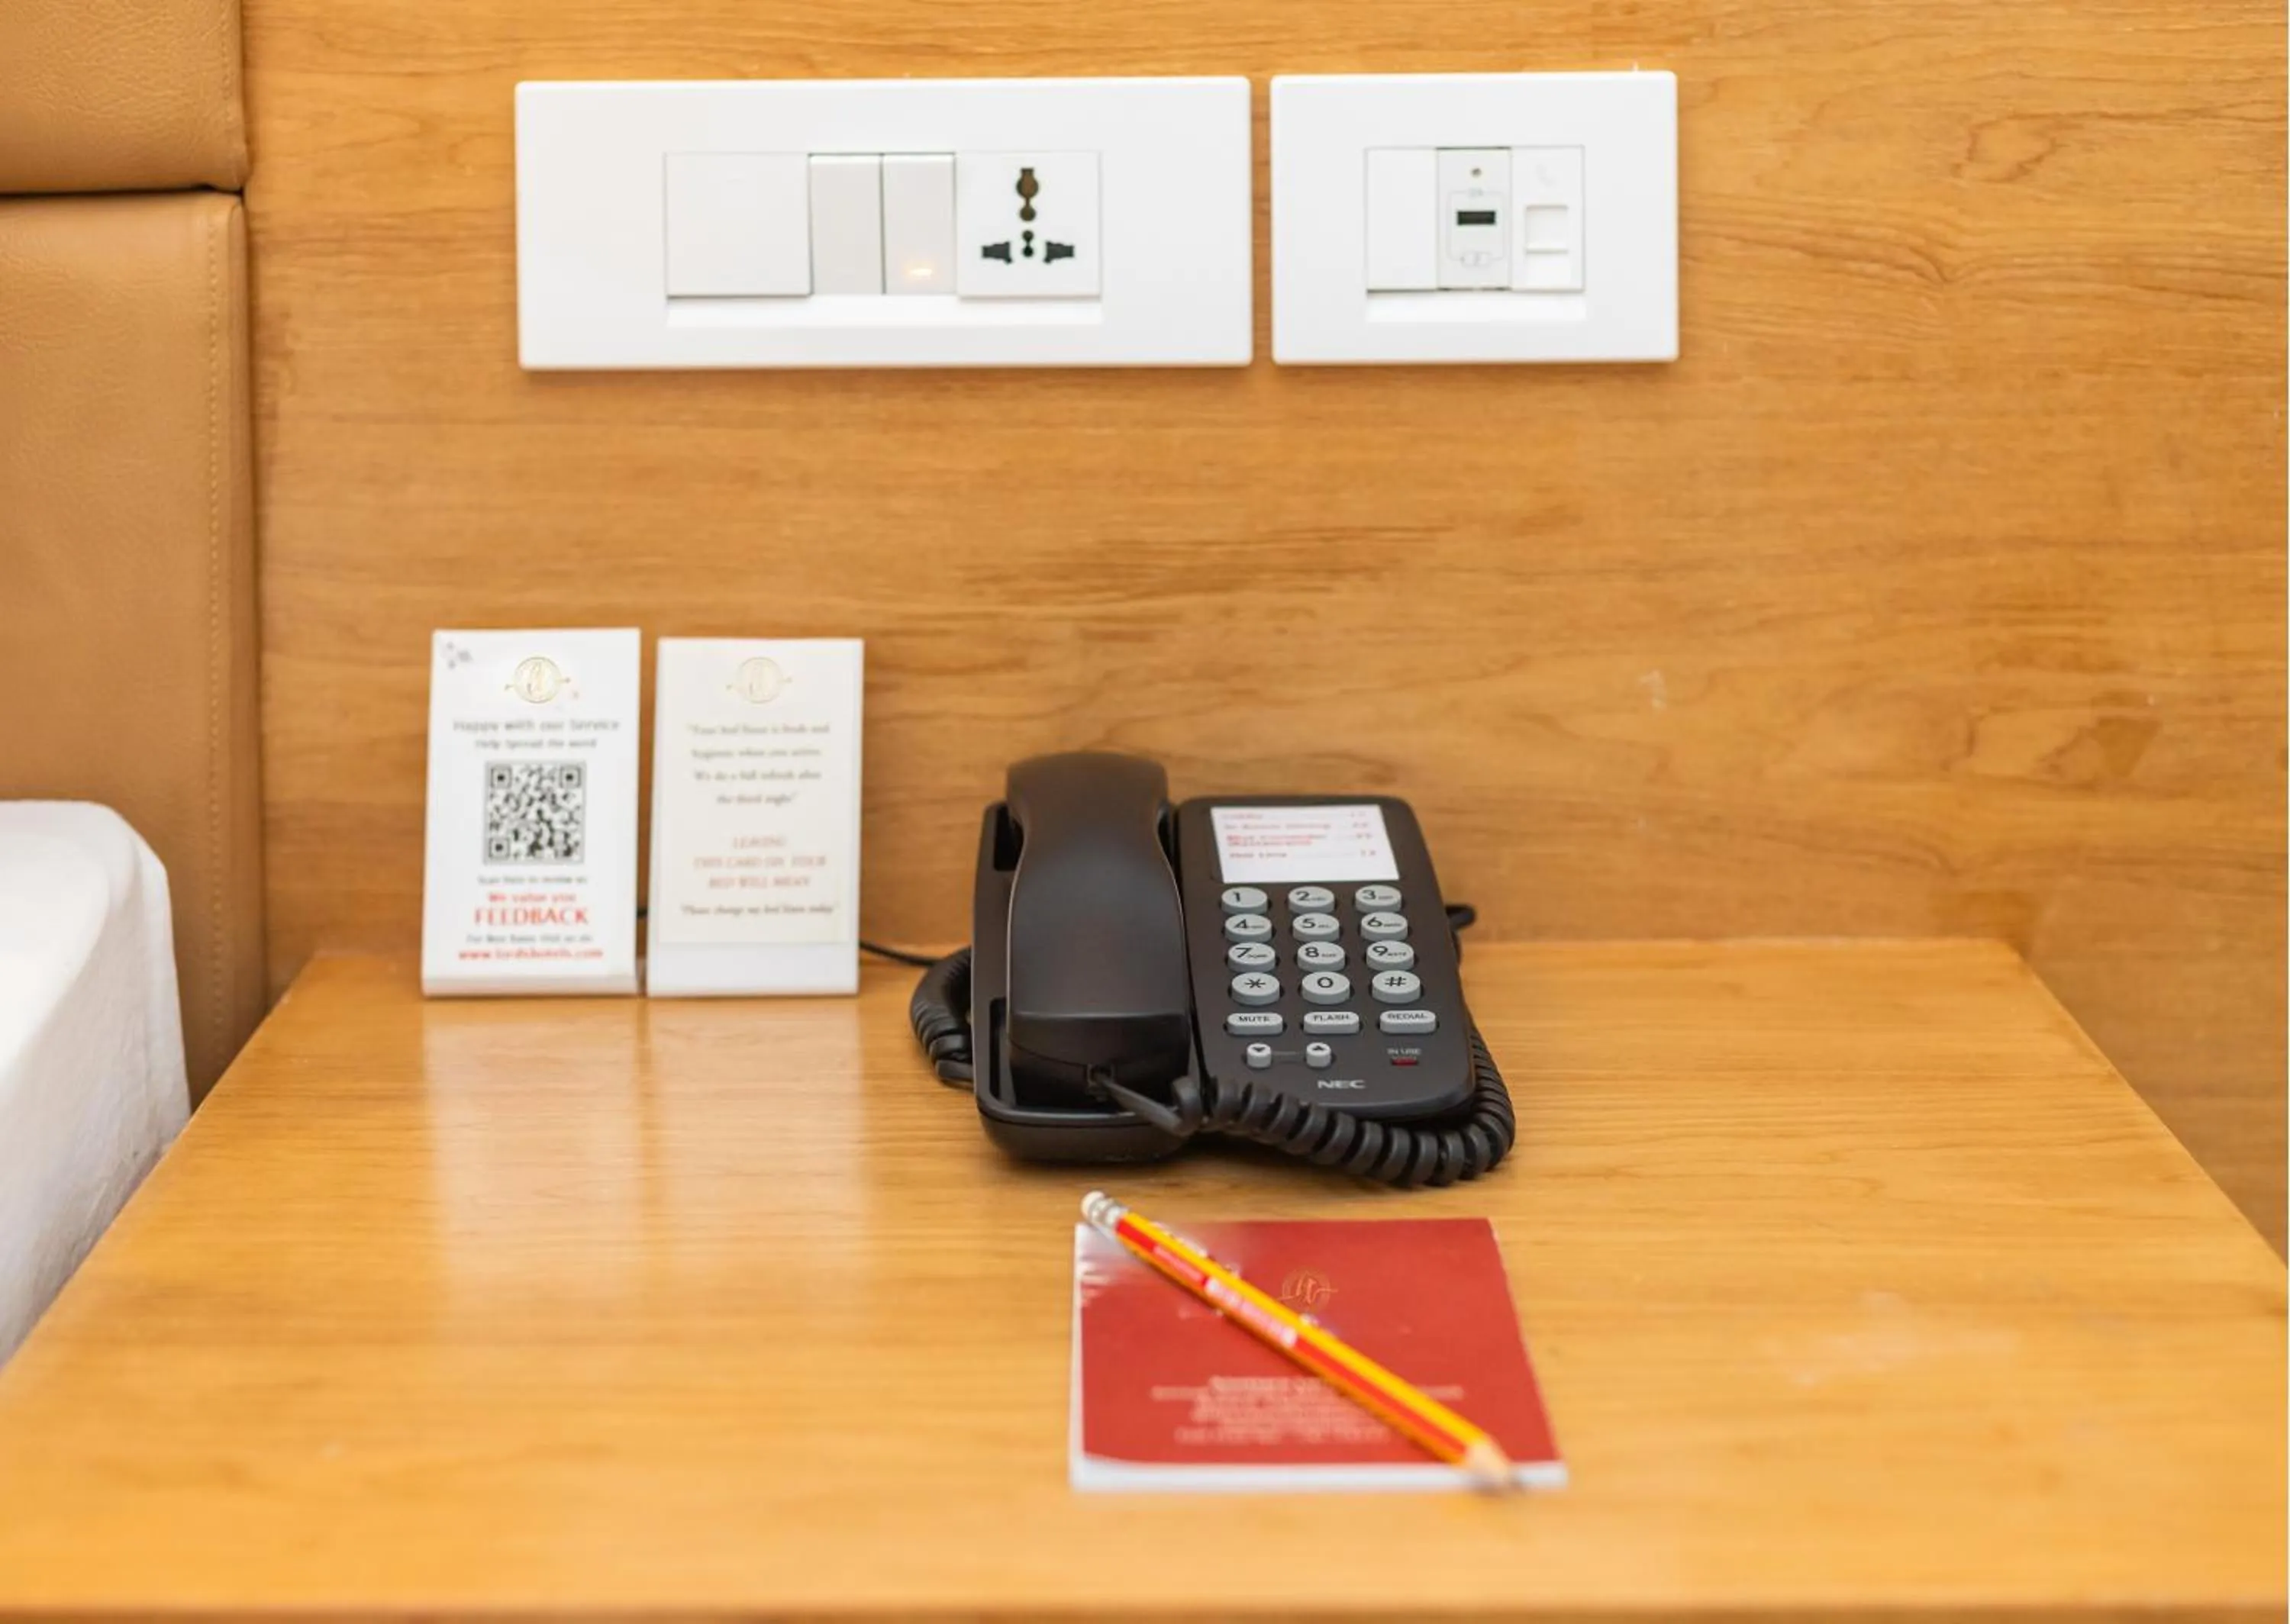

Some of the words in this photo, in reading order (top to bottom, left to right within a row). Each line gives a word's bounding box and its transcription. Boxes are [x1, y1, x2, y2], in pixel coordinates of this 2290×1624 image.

[1232, 891, 1241, 902] 1
[1295, 891, 1311, 901] 2
[1362, 889, 1376, 900] 3
[474, 907, 589, 926] FEEDBACK
[1367, 917, 1382, 927] 6
[1234, 919, 1247, 929] 4
[1301, 918, 1316, 929] 5
[1235, 947, 1253, 959] 7
[1305, 946, 1319, 958] 8
[1372, 946, 1388, 956] 9
[1317, 976, 1334, 988] 0
[1384, 976, 1407, 987] #
[1312, 1013, 1350, 1022] FLASH
[1317, 1079, 1366, 1090] NEC
